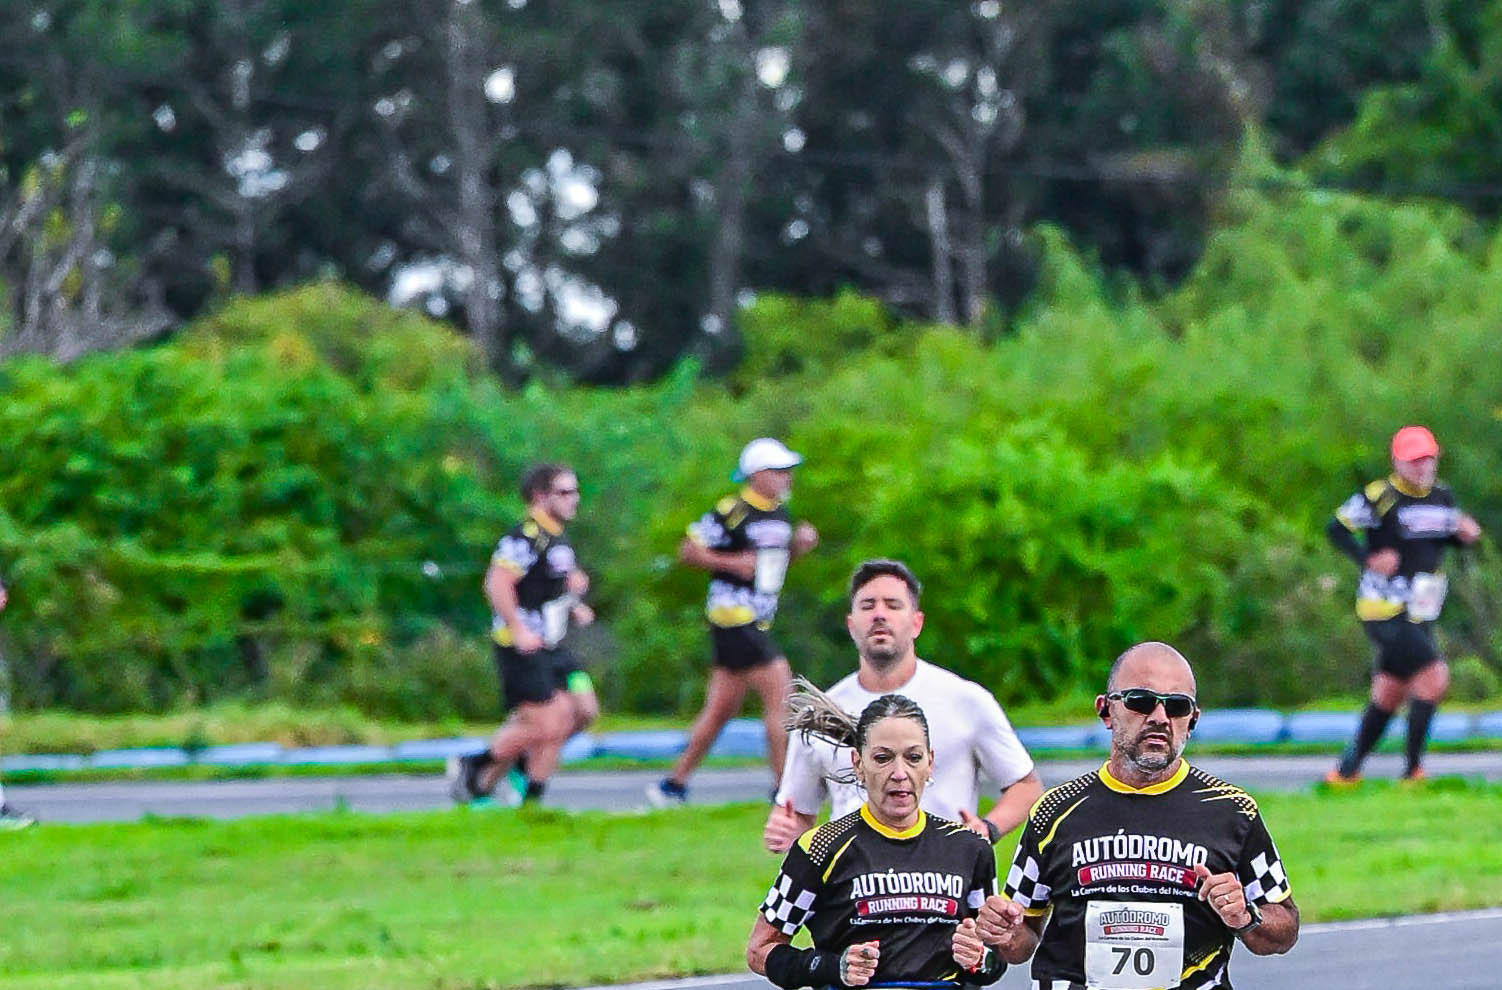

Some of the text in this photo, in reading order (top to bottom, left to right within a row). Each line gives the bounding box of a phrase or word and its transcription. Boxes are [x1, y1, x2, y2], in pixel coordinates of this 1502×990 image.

[1071, 828, 1208, 867] AUTÓDROMO
[1089, 863, 1185, 883] RUNNING RACE
[850, 868, 963, 899] AUTÓDROMO
[1106, 885, 1117, 893] de
[1117, 885, 1130, 893] los
[867, 896, 949, 914] RUNNING RACE
[1100, 906, 1169, 926] AUTÓDROMO
[1111, 947, 1155, 976] 70
